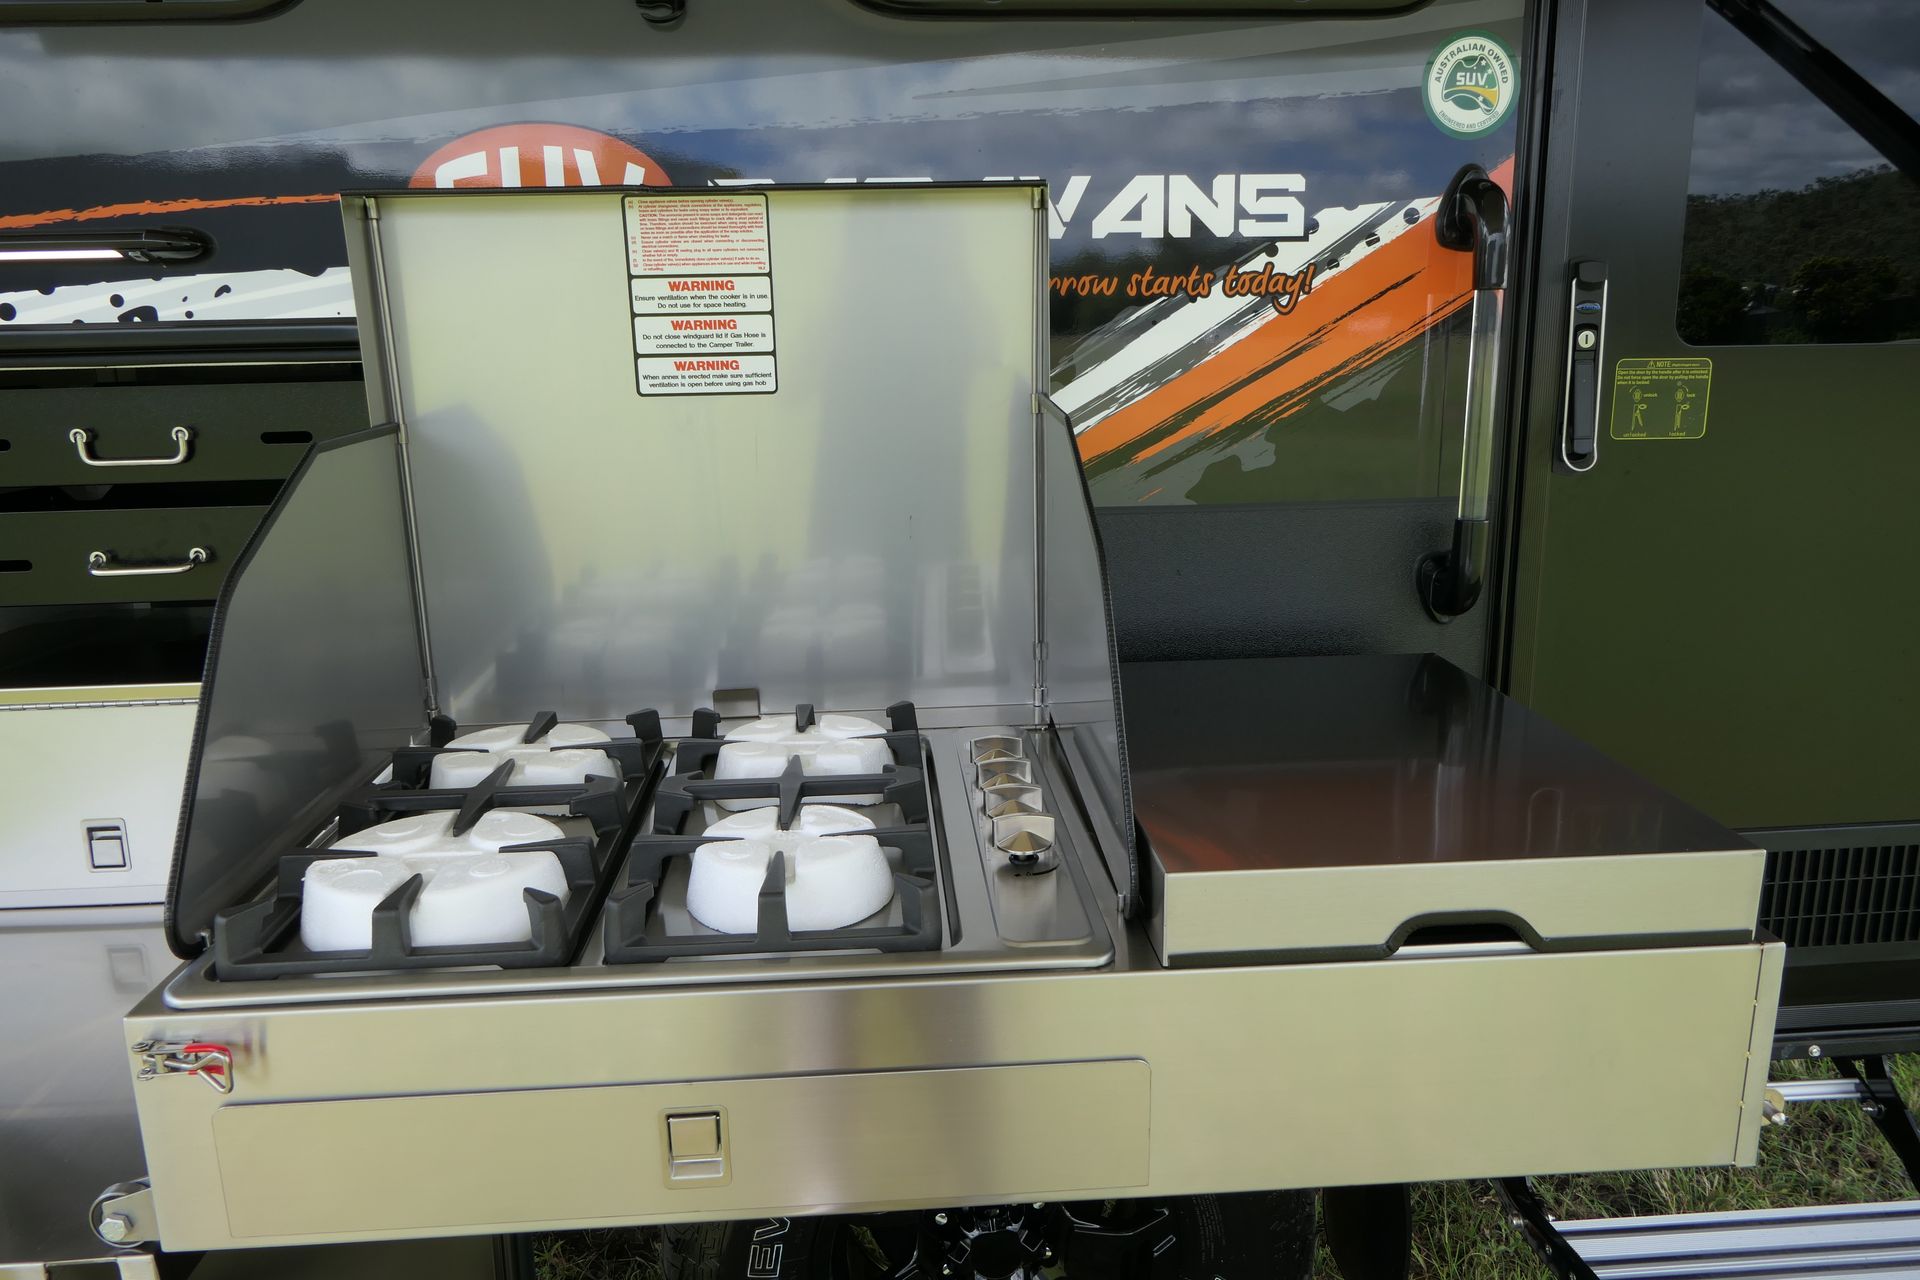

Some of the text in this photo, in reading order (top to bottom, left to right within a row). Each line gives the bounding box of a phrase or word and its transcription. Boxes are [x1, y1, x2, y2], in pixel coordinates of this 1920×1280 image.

[1435, 43, 1508, 83] AUSTRALIAN OWNED
[1456, 73, 1487, 85] SUV
[1439, 110, 1465, 128] ENGINEERED
[668, 280, 735, 291] WARNING
[1048, 262, 1315, 315] rrow starts today!
[671, 320, 737, 330] WARNING
[674, 360, 739, 371] WARNING
